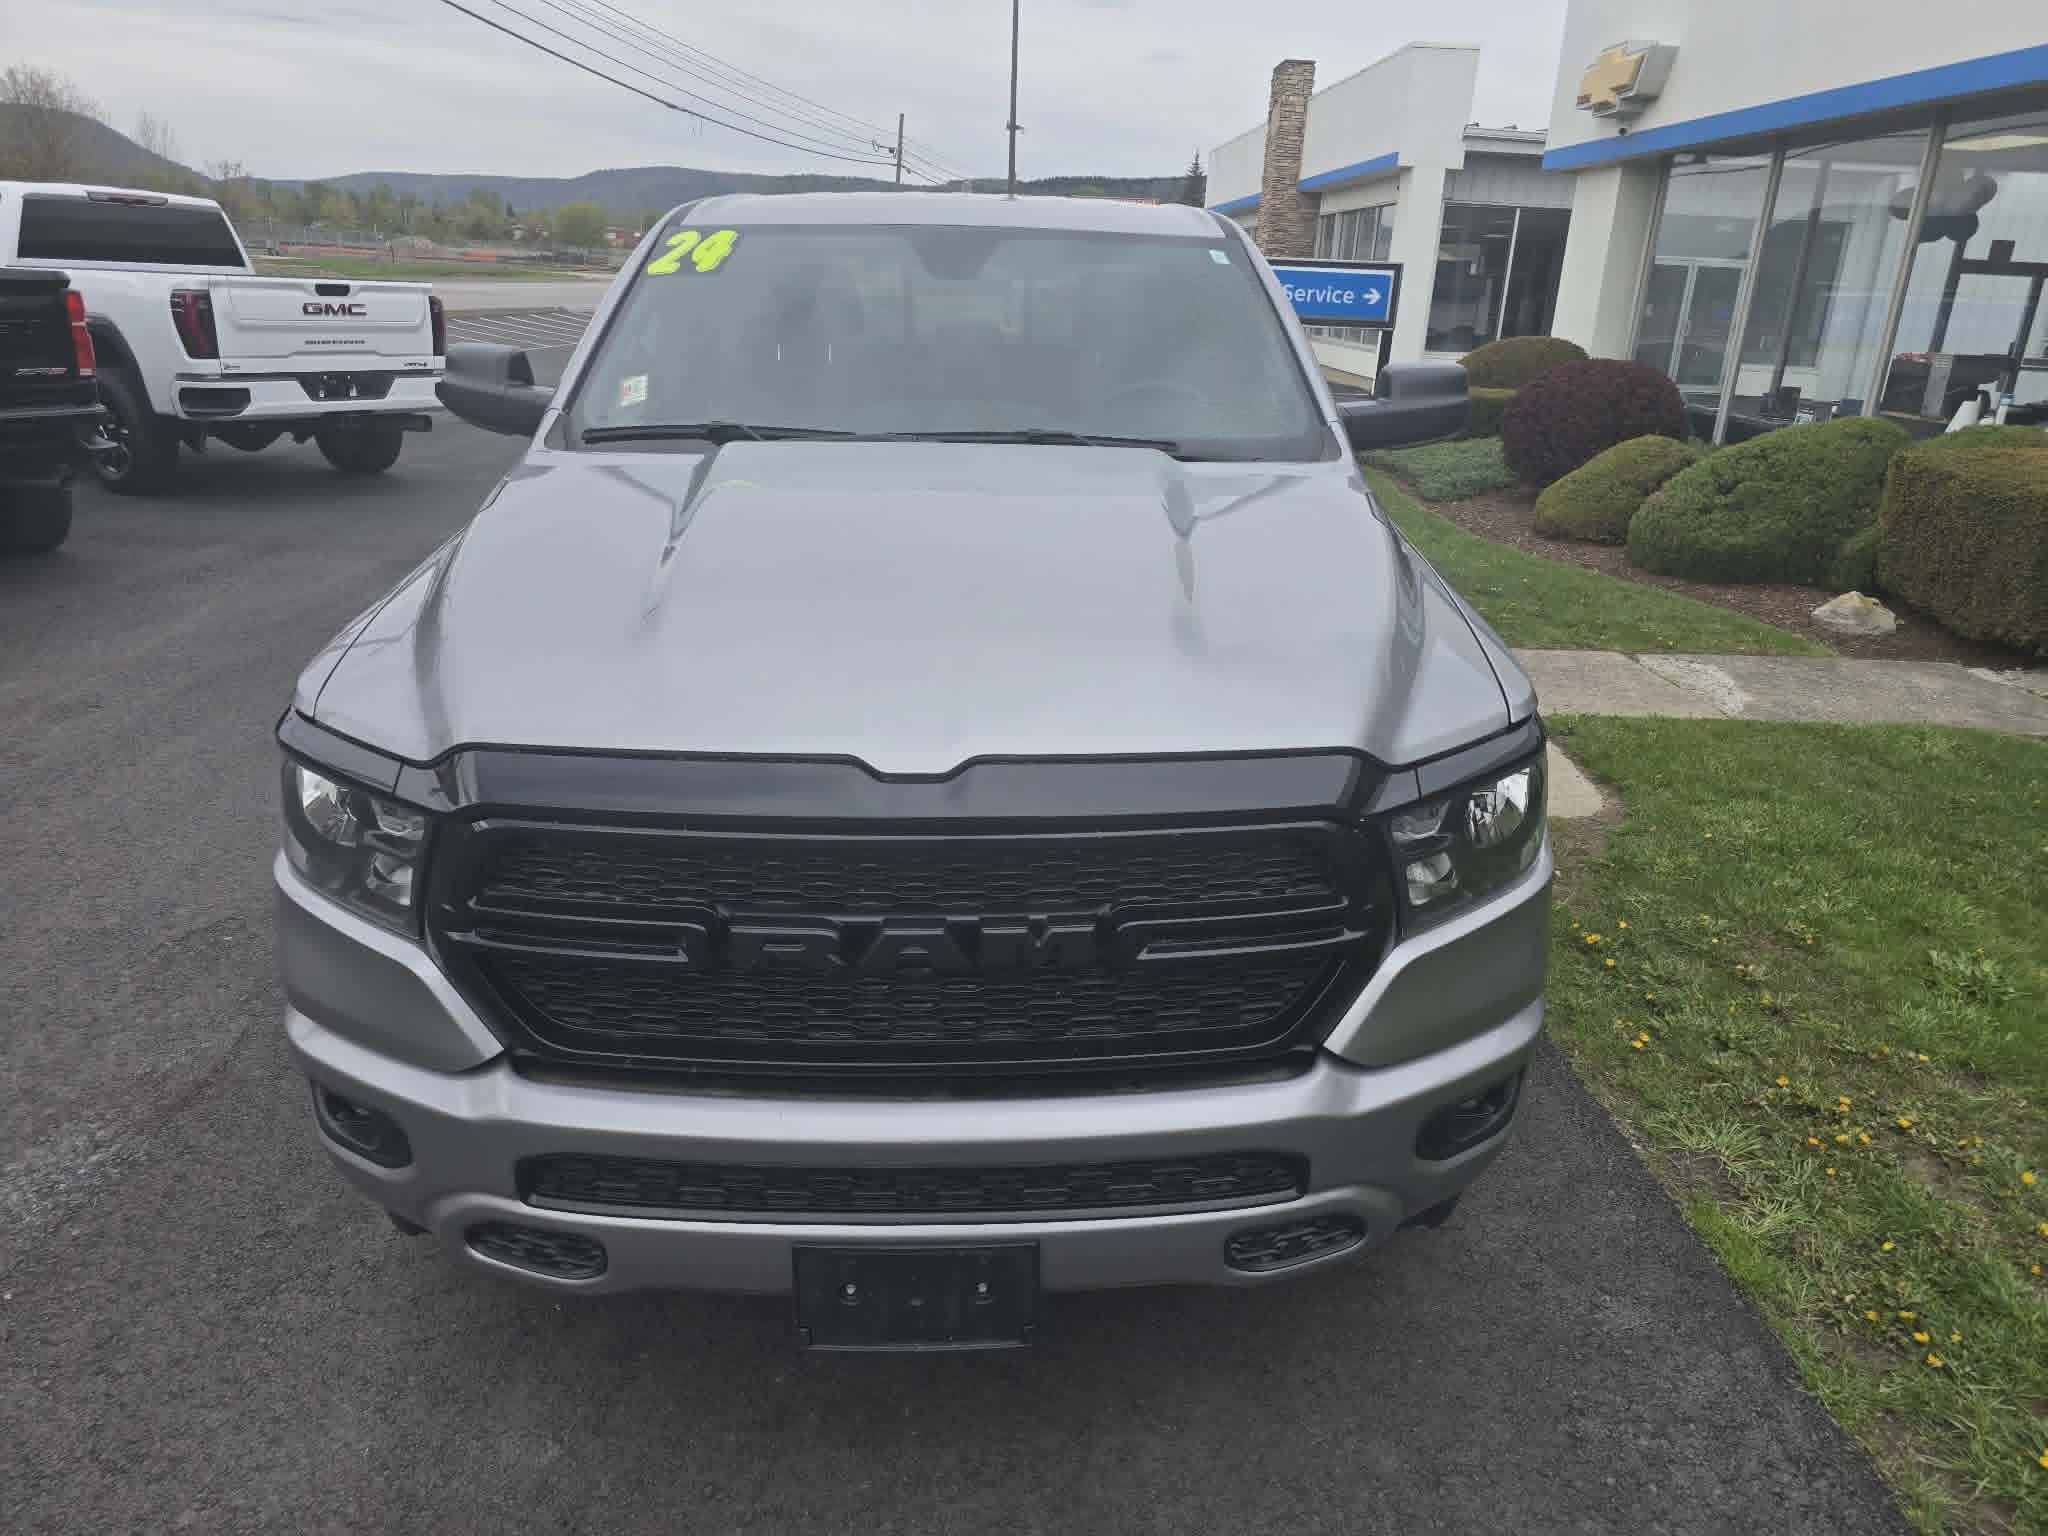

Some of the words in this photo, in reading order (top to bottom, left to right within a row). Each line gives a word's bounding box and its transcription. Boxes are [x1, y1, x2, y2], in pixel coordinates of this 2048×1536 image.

[647, 229, 738, 275] 24
[302, 302, 368, 316] GMC
[1281, 283, 1355, 304] Service
[727, 922, 1100, 970] RAM
